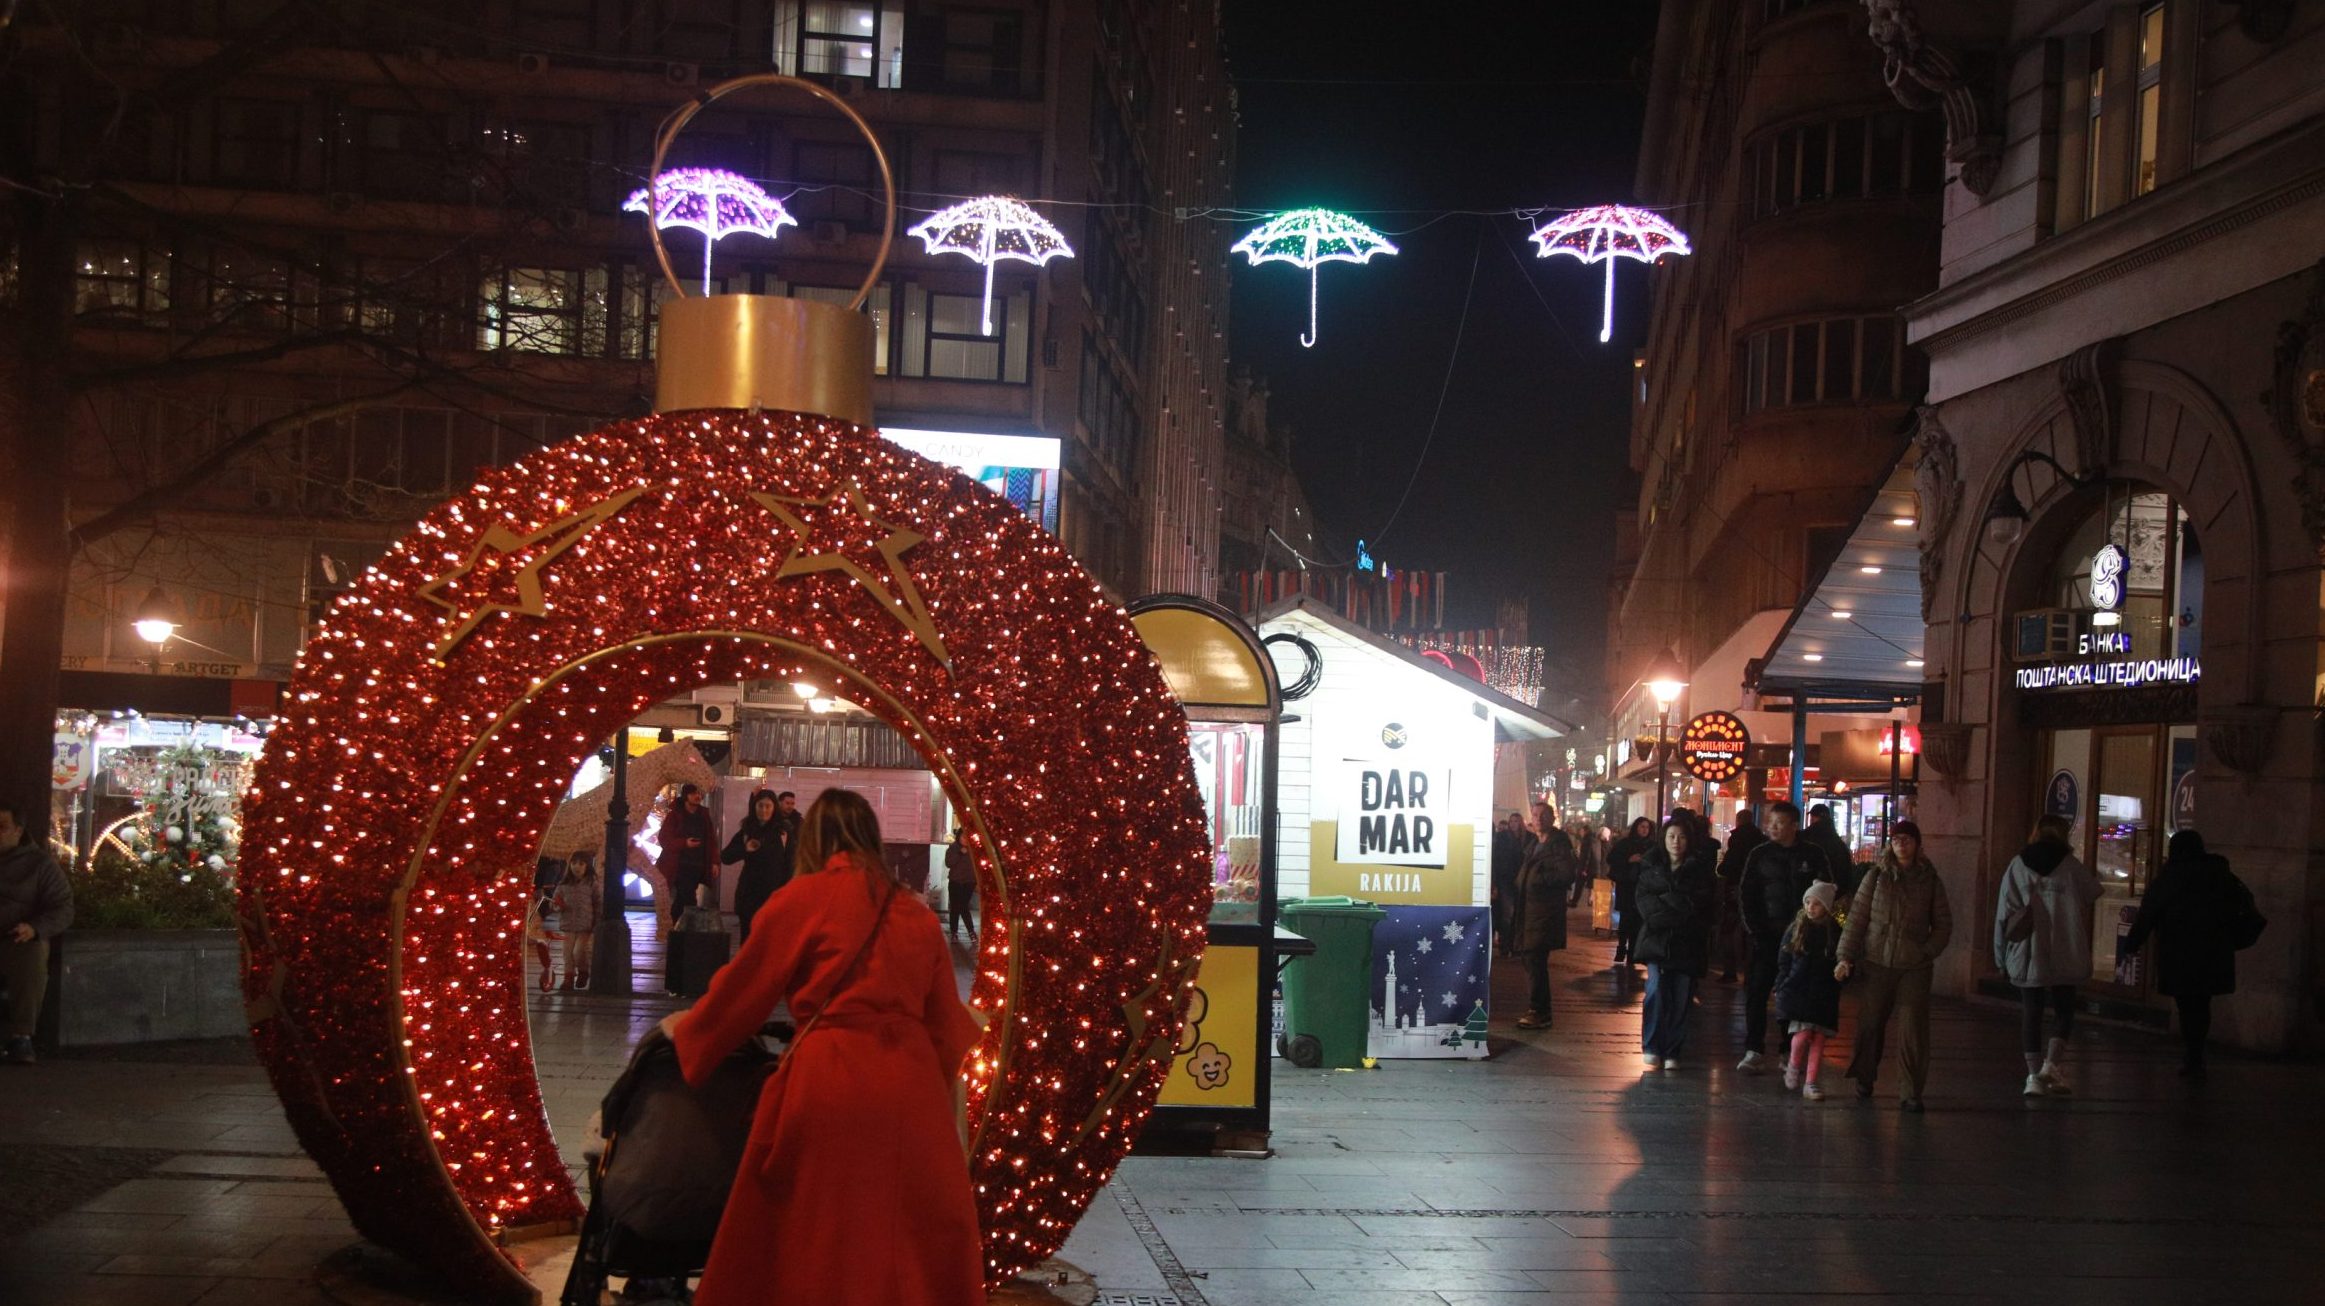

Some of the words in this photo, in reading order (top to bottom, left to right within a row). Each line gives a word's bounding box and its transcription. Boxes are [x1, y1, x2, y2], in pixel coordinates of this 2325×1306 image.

[925, 442, 985, 458] CANDY
[2079, 632, 2125, 655] БАНКА
[174, 660, 241, 677] ARTGET
[2016, 664, 2091, 689] ПОШТАНСКА
[2094, 656, 2201, 687] ШТЕДИОНИЦА
[1361, 768, 1429, 811] DAR
[1359, 813, 1434, 855] MAR
[1360, 873, 1422, 893] RAKIJA
